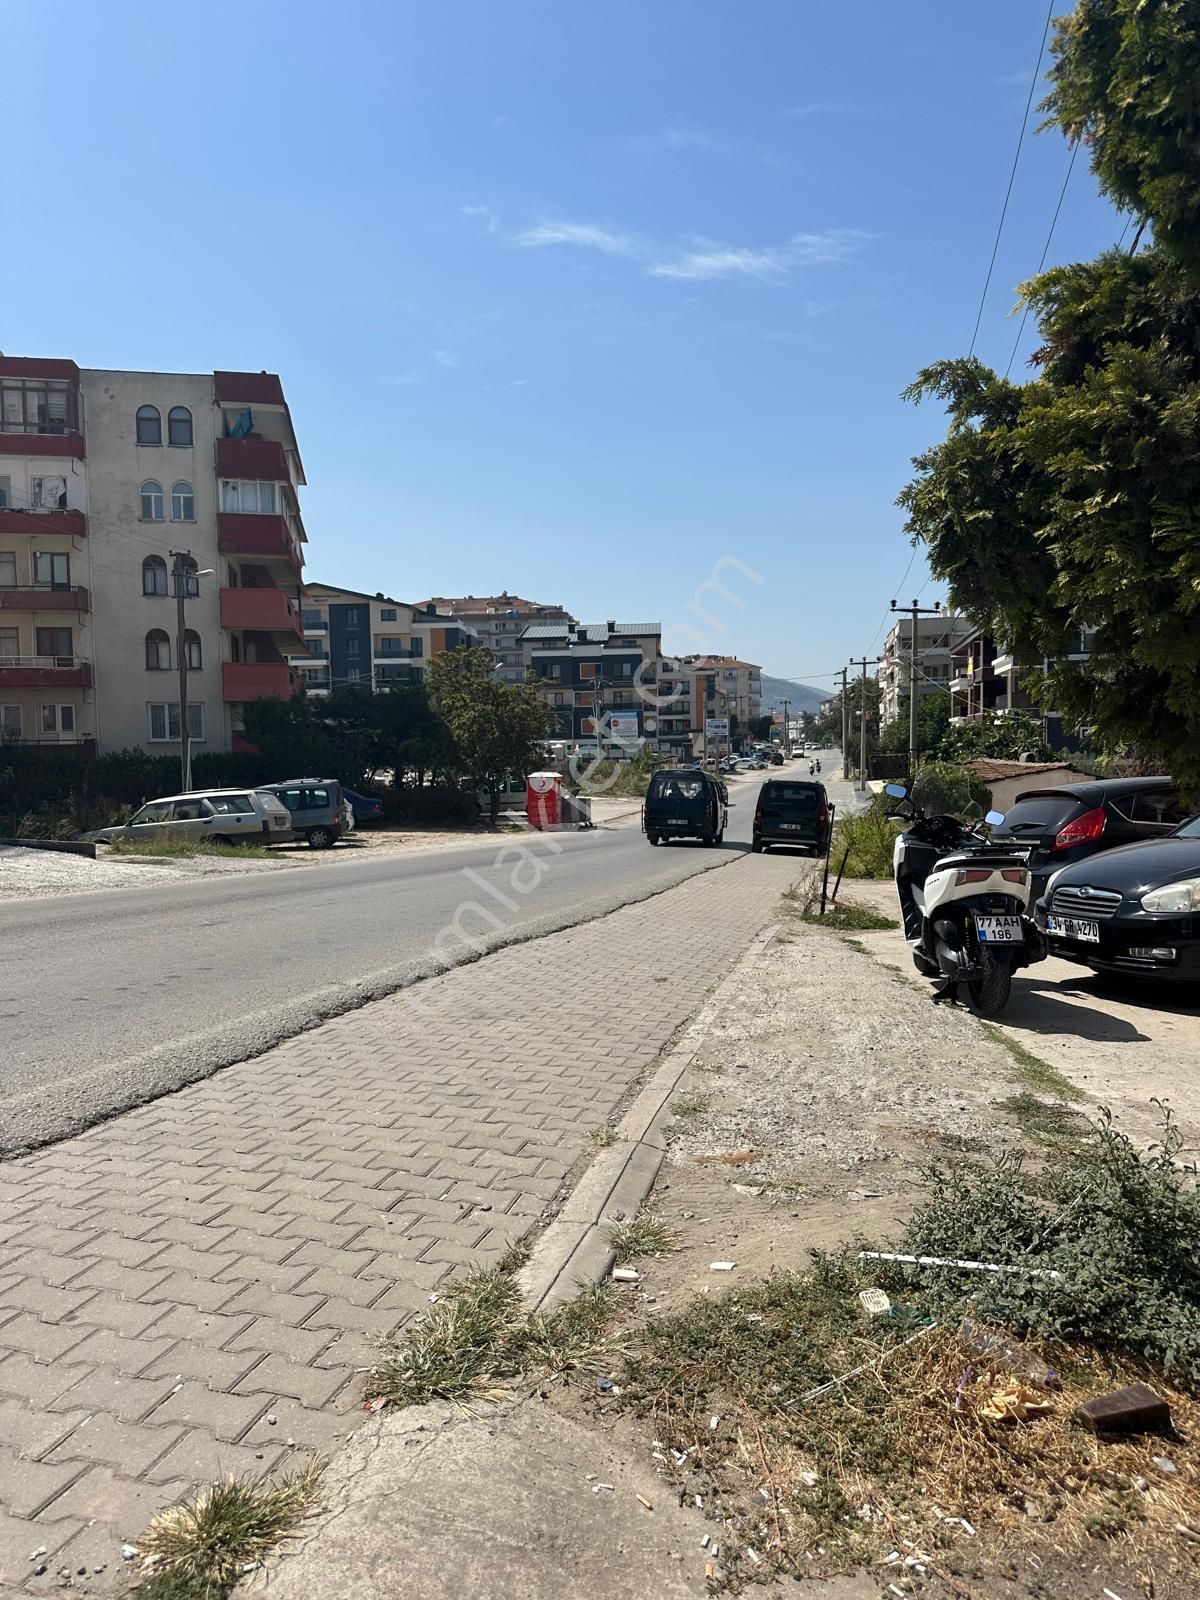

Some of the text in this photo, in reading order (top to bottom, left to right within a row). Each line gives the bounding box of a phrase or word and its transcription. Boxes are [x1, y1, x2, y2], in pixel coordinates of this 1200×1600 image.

[979, 917, 1020, 928] 77 AAH
[1053, 916, 1097, 937] 34 GR 4270
[992, 929, 1012, 939] 196
